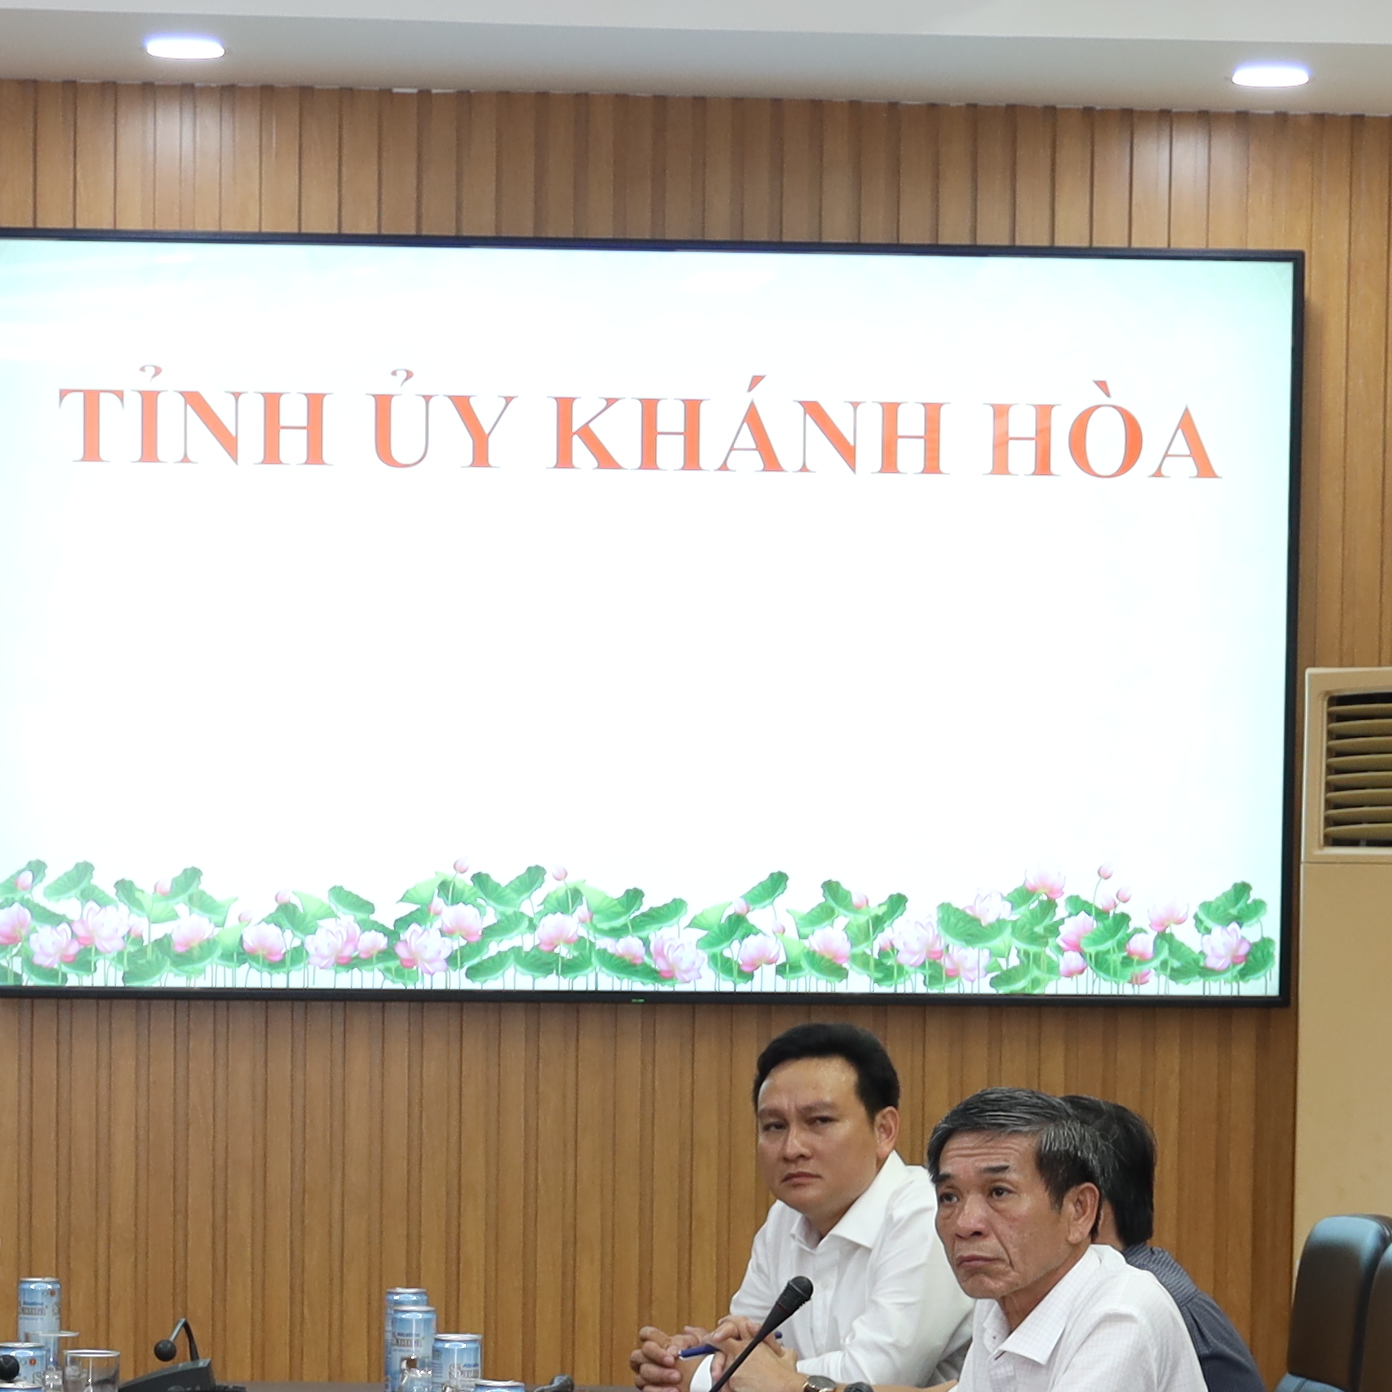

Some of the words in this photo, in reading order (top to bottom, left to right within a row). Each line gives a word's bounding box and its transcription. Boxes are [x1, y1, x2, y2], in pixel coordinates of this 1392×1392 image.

[59, 364, 330, 464] TỈNH
[366, 368, 516, 467] ỦY
[547, 375, 948, 475] KHÁNH
[984, 380, 1223, 479] HÒA
